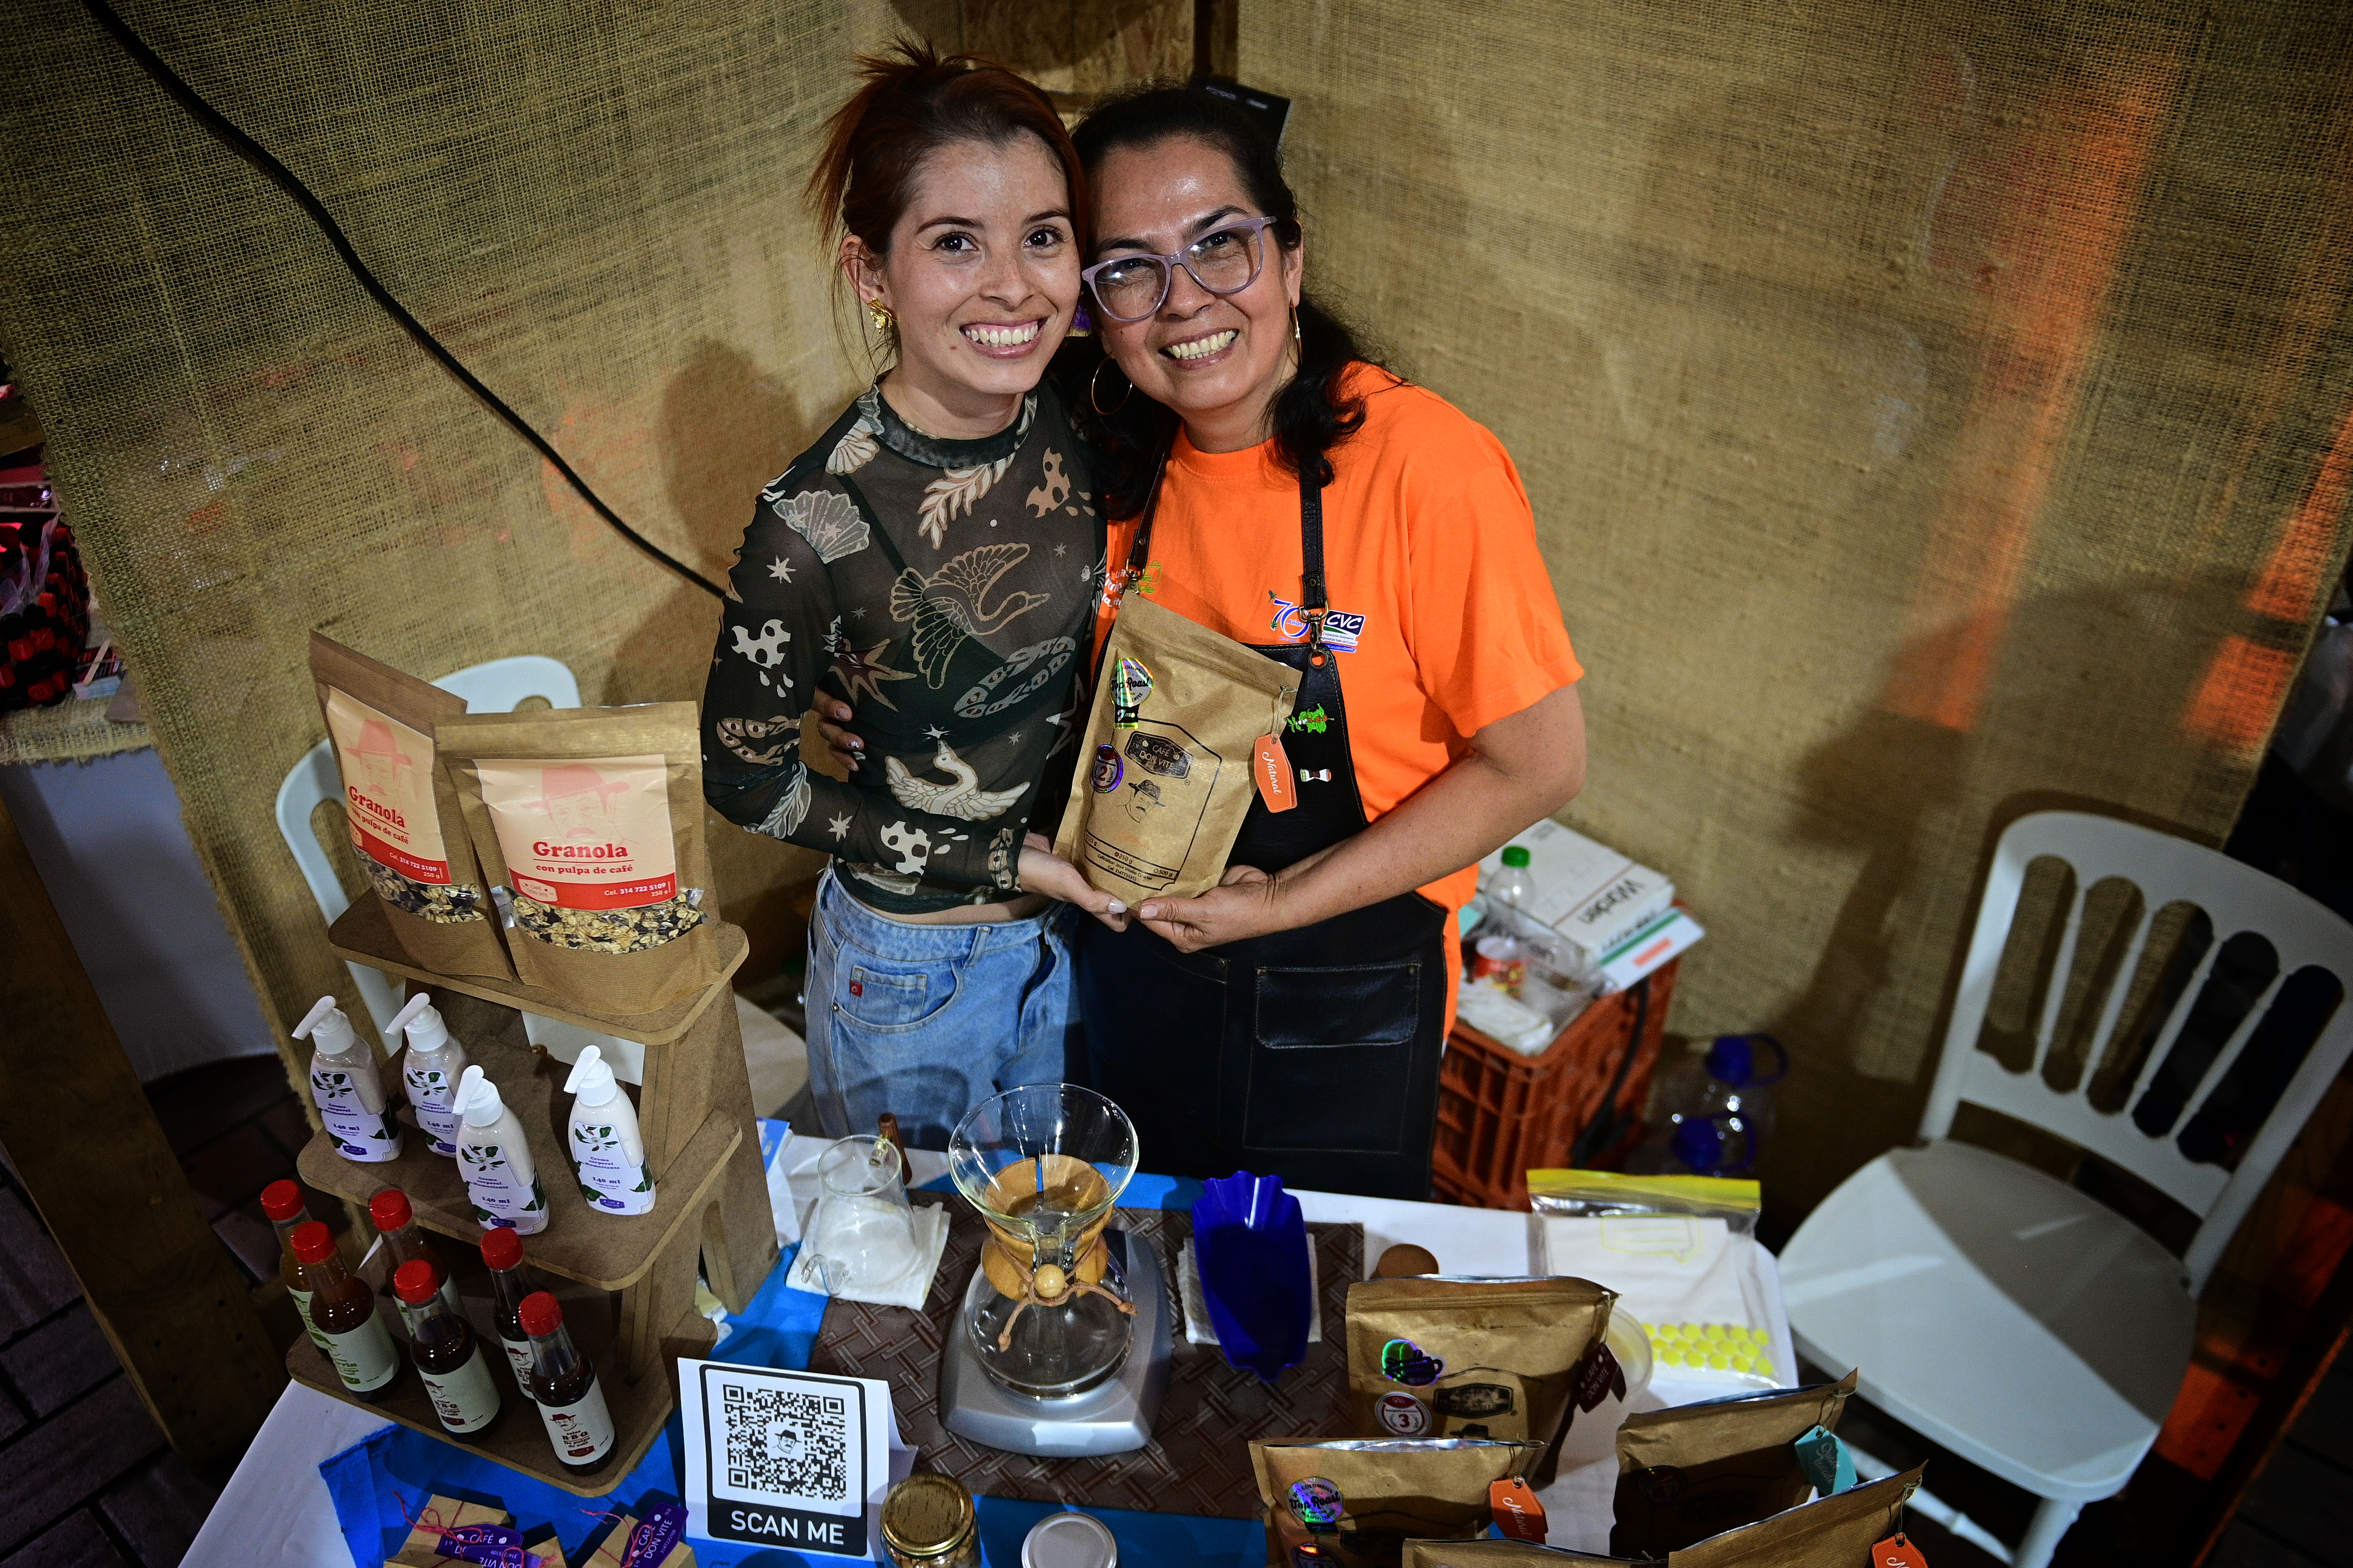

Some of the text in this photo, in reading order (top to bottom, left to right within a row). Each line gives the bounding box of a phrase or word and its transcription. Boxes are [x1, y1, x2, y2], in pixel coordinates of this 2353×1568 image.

[1287, 619, 1304, 627] Años
[1326, 614, 1362, 629] CVC
[1126, 677, 1150, 691] Roast
[1152, 745, 1171, 757] CAFÉ
[1139, 751, 1174, 768] DON VITE
[1098, 765, 1108, 781] 2
[1262, 752, 1282, 795] Natural
[349, 785, 406, 828] Granola
[362, 814, 381, 831] pulpa
[383, 827, 391, 836] de
[393, 832, 409, 844] café
[533, 841, 629, 858] Granola
[399, 857, 409, 865] 314
[410, 860, 420, 869] 722
[536, 864, 554, 872] con
[558, 866, 590, 875] pulpa
[610, 864, 633, 873] café
[1398, 1413, 1410, 1427] 3
[1289, 1499, 1311, 1510] Top
[1311, 1491, 1341, 1510] Roast
[730, 1510, 844, 1545] SCAN ME
[643, 1519, 673, 1559] DON VITE
